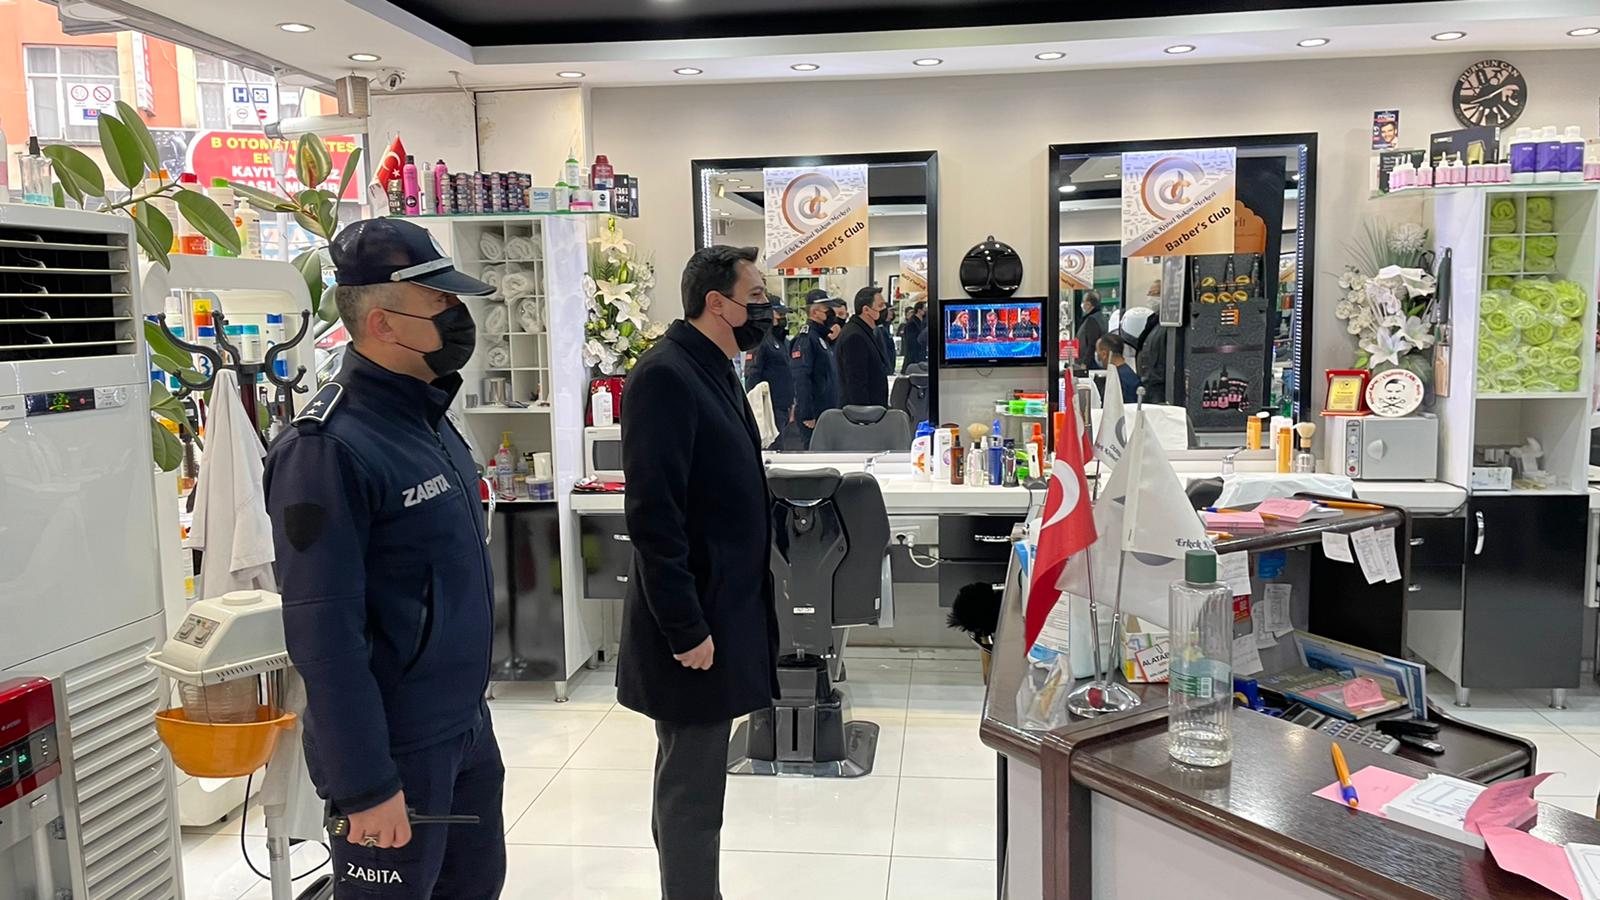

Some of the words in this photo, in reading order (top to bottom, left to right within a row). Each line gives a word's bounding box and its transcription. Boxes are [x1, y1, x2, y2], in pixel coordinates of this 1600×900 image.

[1460, 61, 1498, 83] DURSUN
[1500, 62, 1519, 77] CAN
[210, 136, 222, 149] B
[1164, 222, 1208, 252] Barber's
[1207, 206, 1232, 224] Club
[805, 236, 844, 265] Barber's
[843, 221, 865, 239] Club
[402, 474, 451, 507] ZABITA
[347, 862, 403, 884] ZABITA
